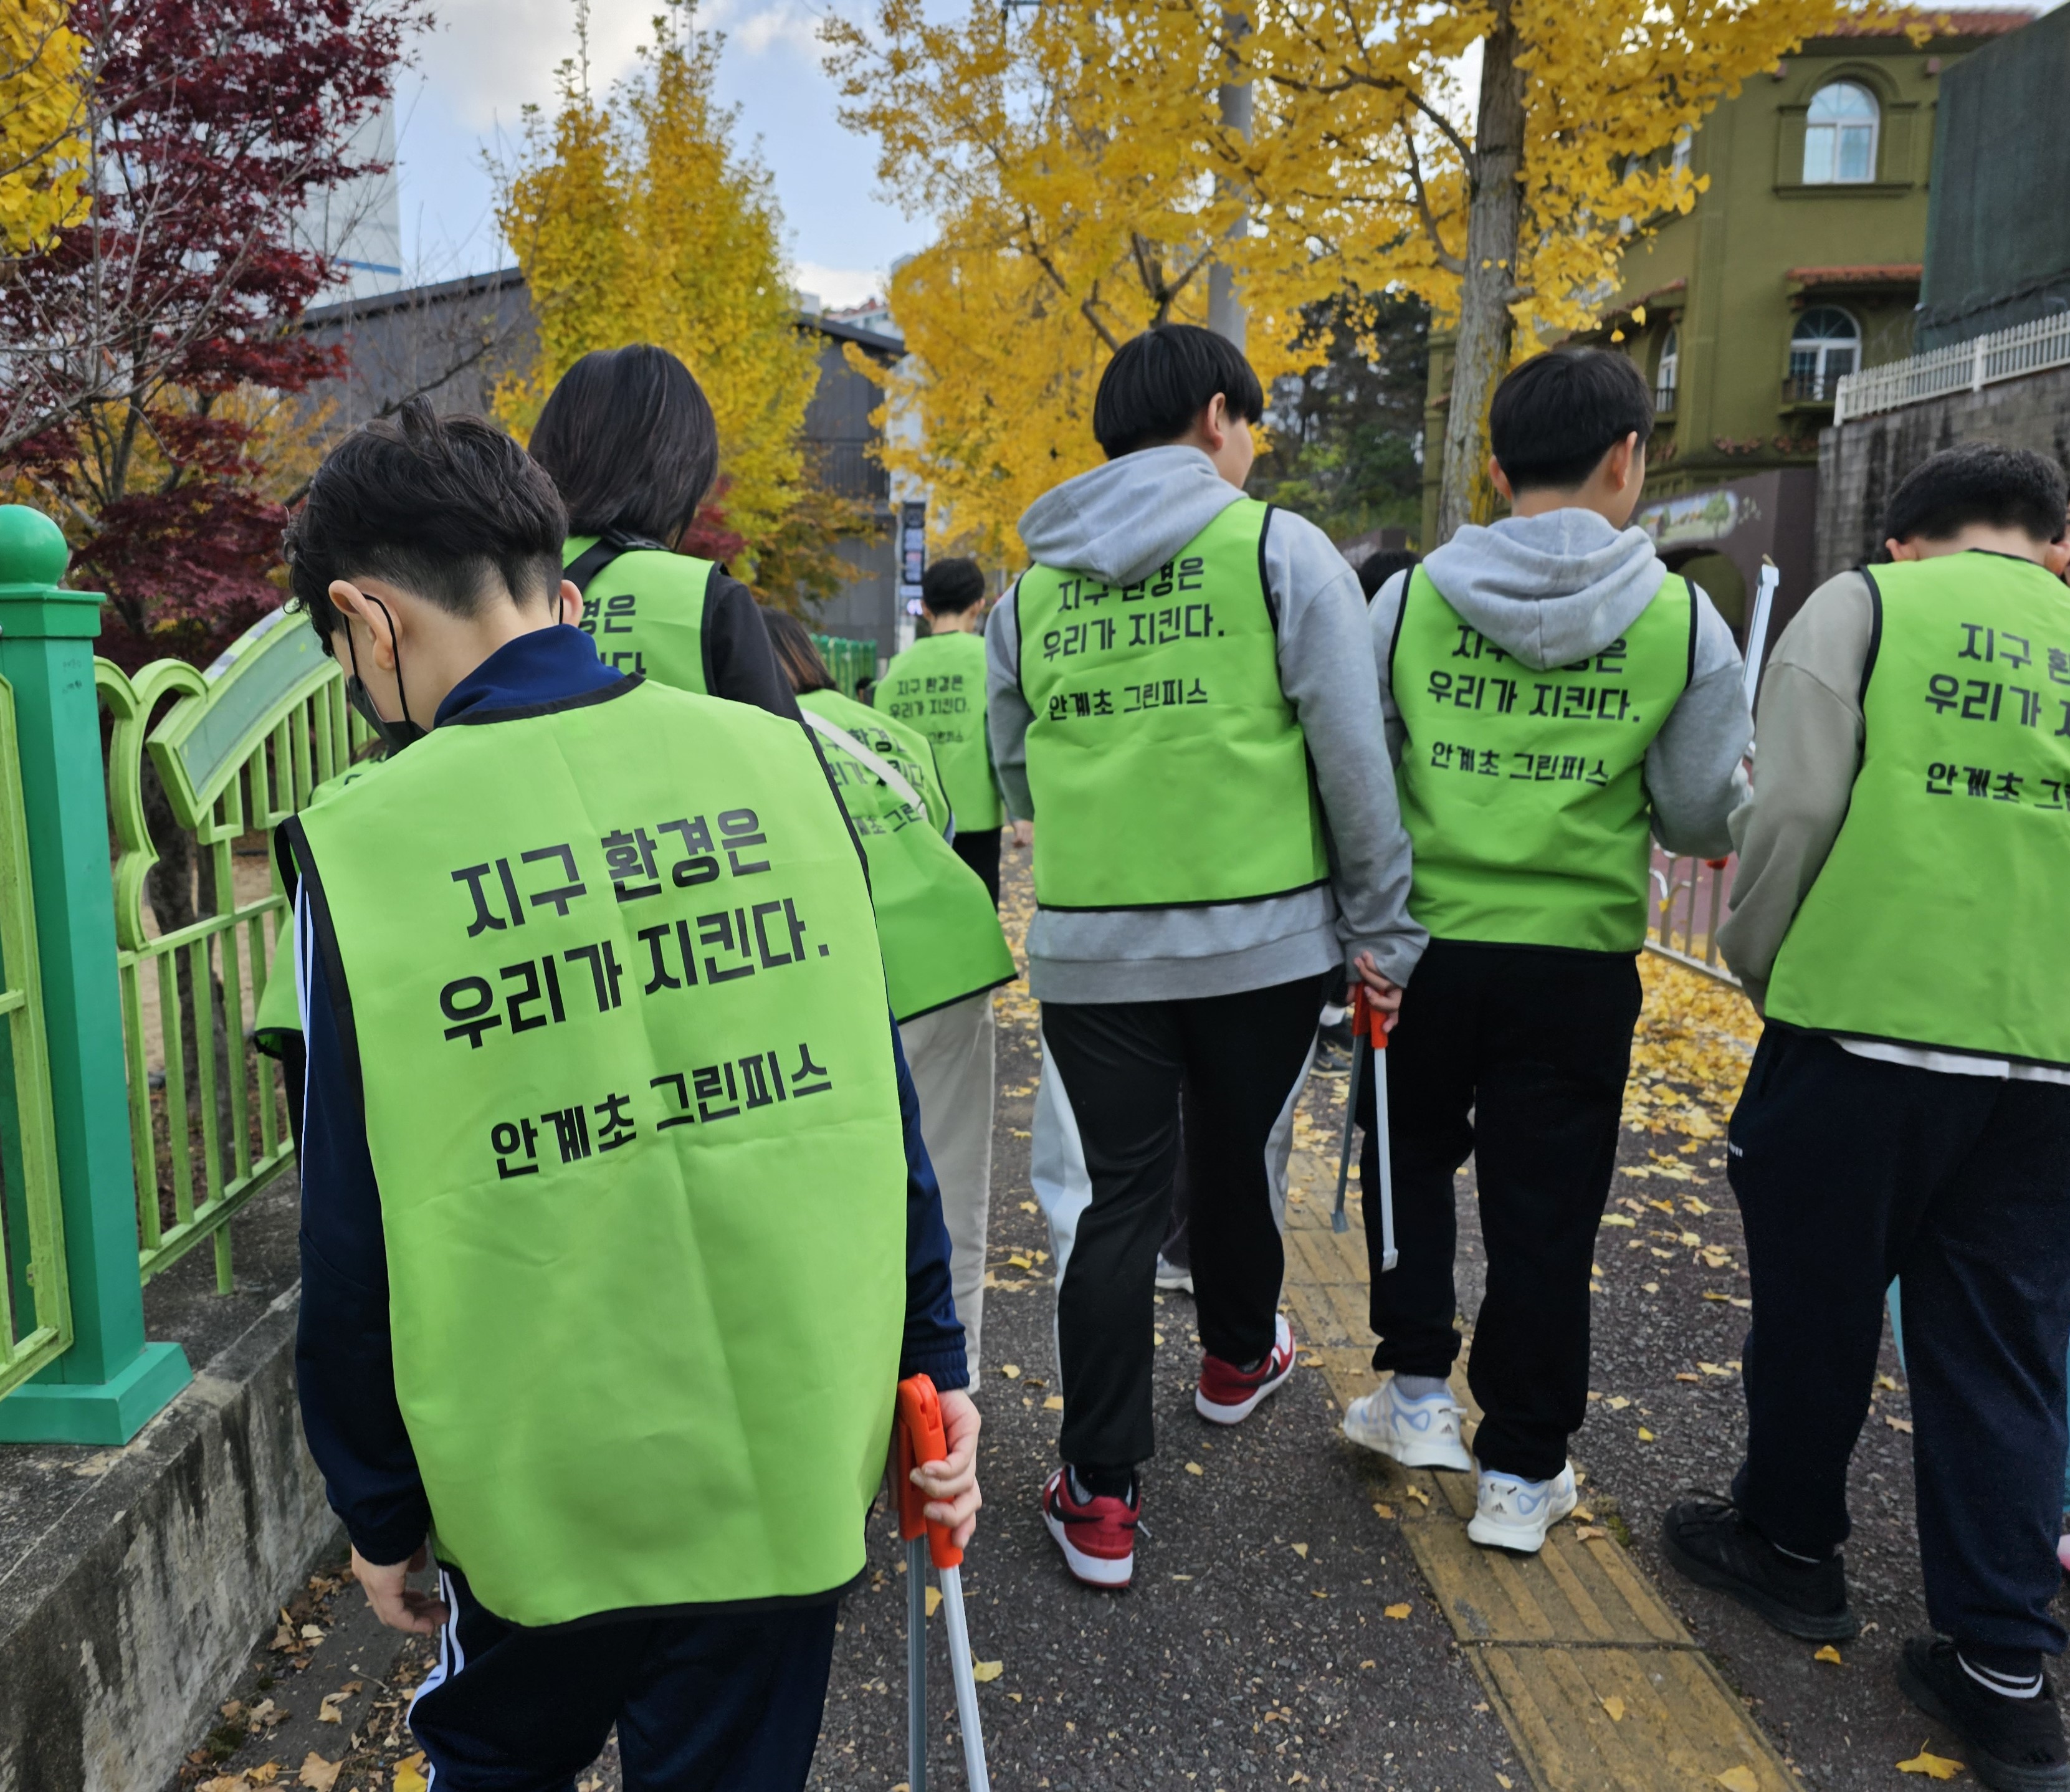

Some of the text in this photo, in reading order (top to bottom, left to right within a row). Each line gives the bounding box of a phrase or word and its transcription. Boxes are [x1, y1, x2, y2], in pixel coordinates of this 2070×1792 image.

[578, 594, 636, 635] 경은
[1043, 603, 1224, 662] 우리가 지킨다.
[1958, 622, 2031, 669] 지구
[1049, 678, 1208, 721] 안계초 그린피스
[1428, 670, 1640, 722] 우리가 지킨다.
[1925, 674, 2041, 728] 우리가
[1431, 741, 1609, 786] 안계초 그린피스
[1926, 762, 2023, 804] 안계초
[451, 808, 771, 938] 지구 환경은
[439, 897, 830, 1049] 우리가 지킨다.
[491, 1042, 832, 1180] 안계초 그린피스
